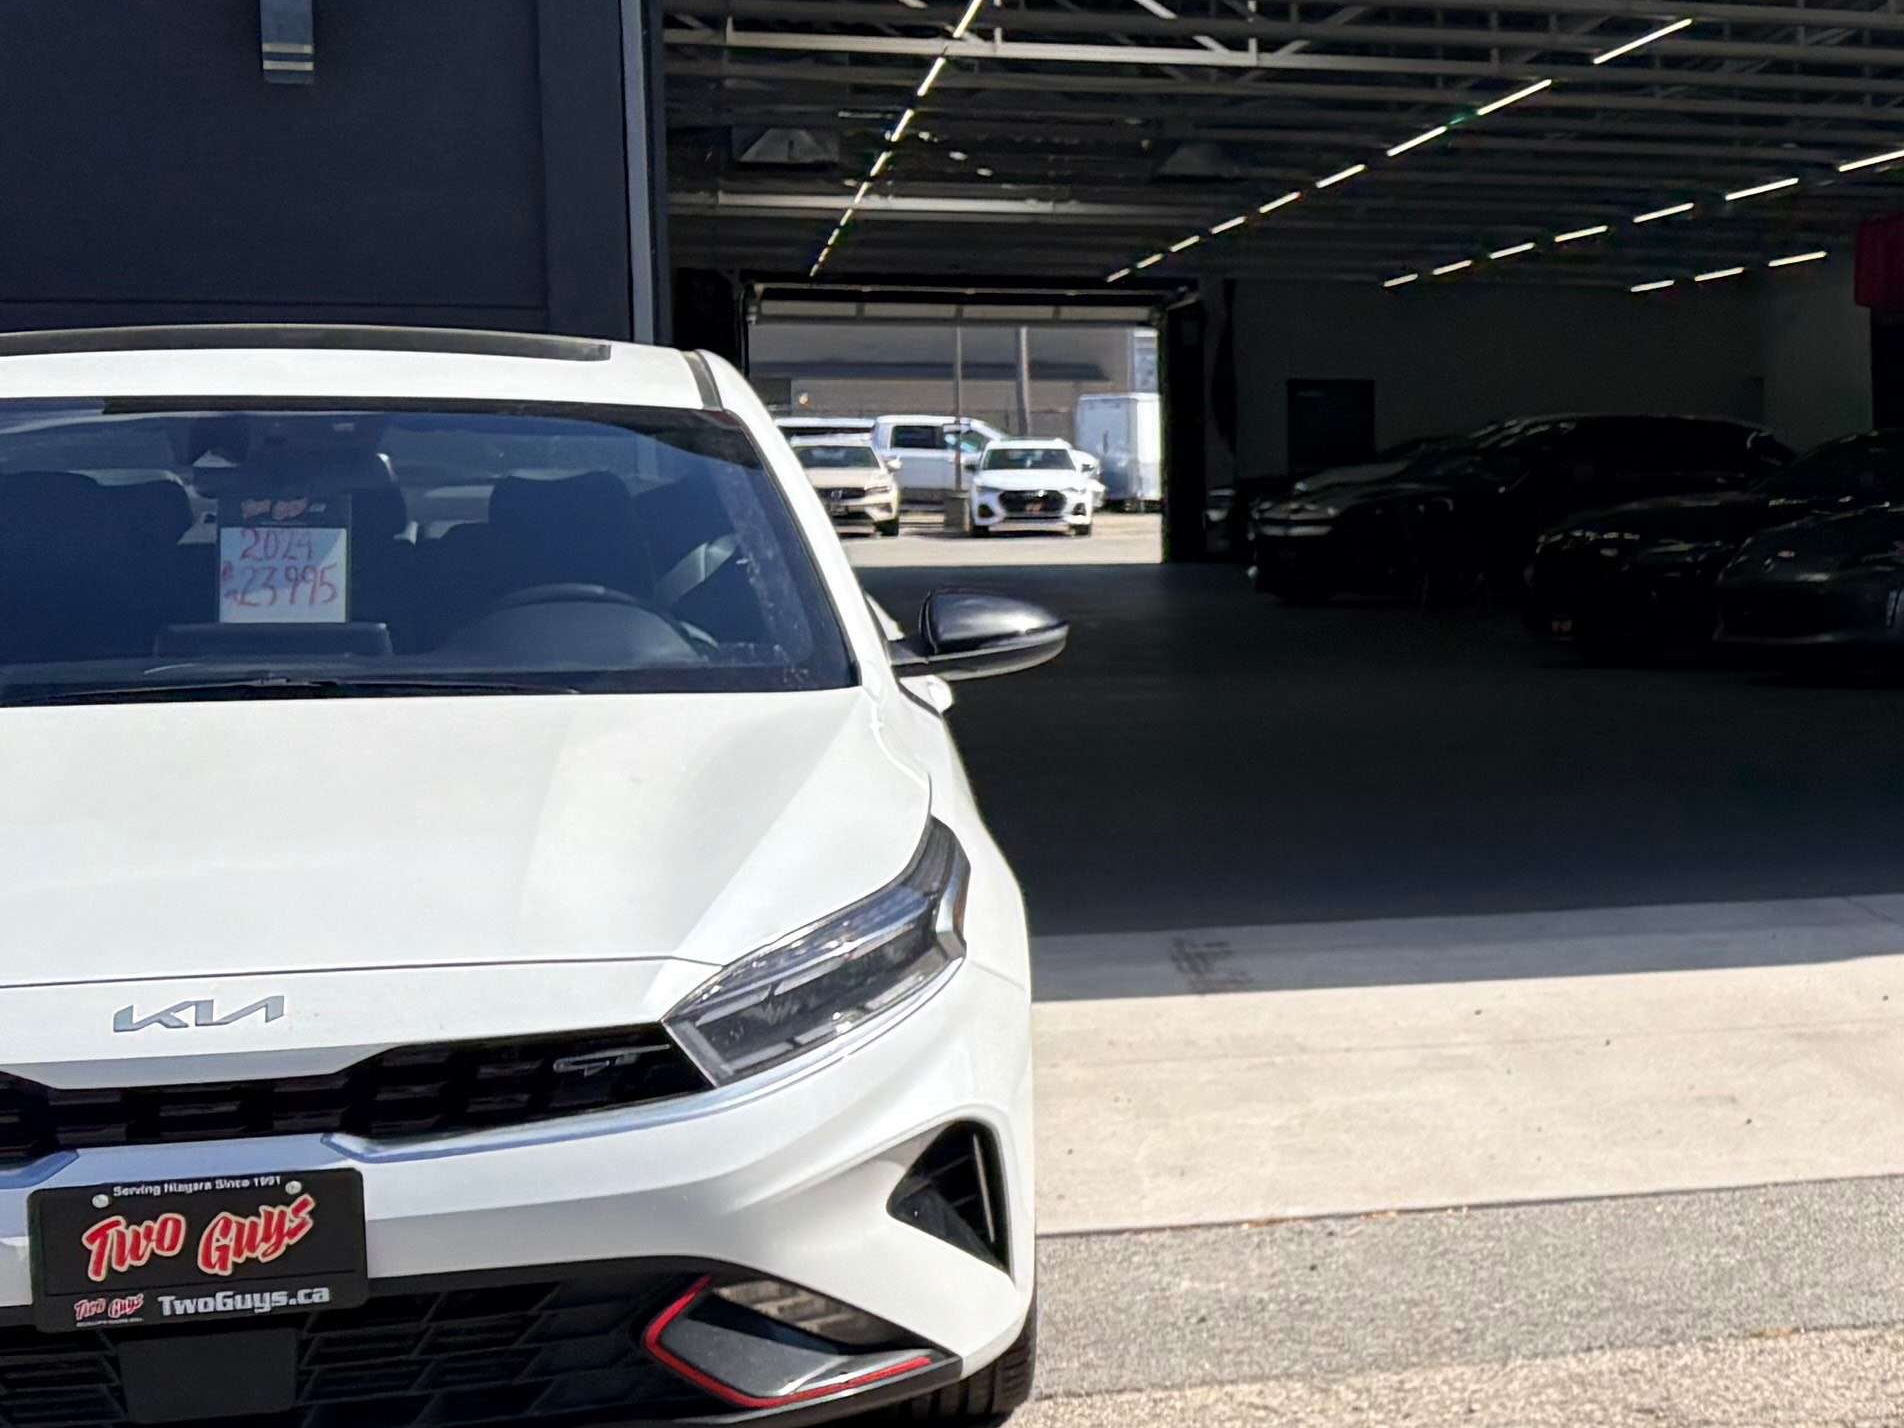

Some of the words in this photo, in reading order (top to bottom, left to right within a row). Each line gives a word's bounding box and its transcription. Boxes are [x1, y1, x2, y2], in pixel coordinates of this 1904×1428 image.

[113, 995, 285, 1033] KIA
[82, 1214, 186, 1282] Two
[198, 1193, 315, 1276] Guys
[157, 1286, 331, 1315] TwoGuys.ca
